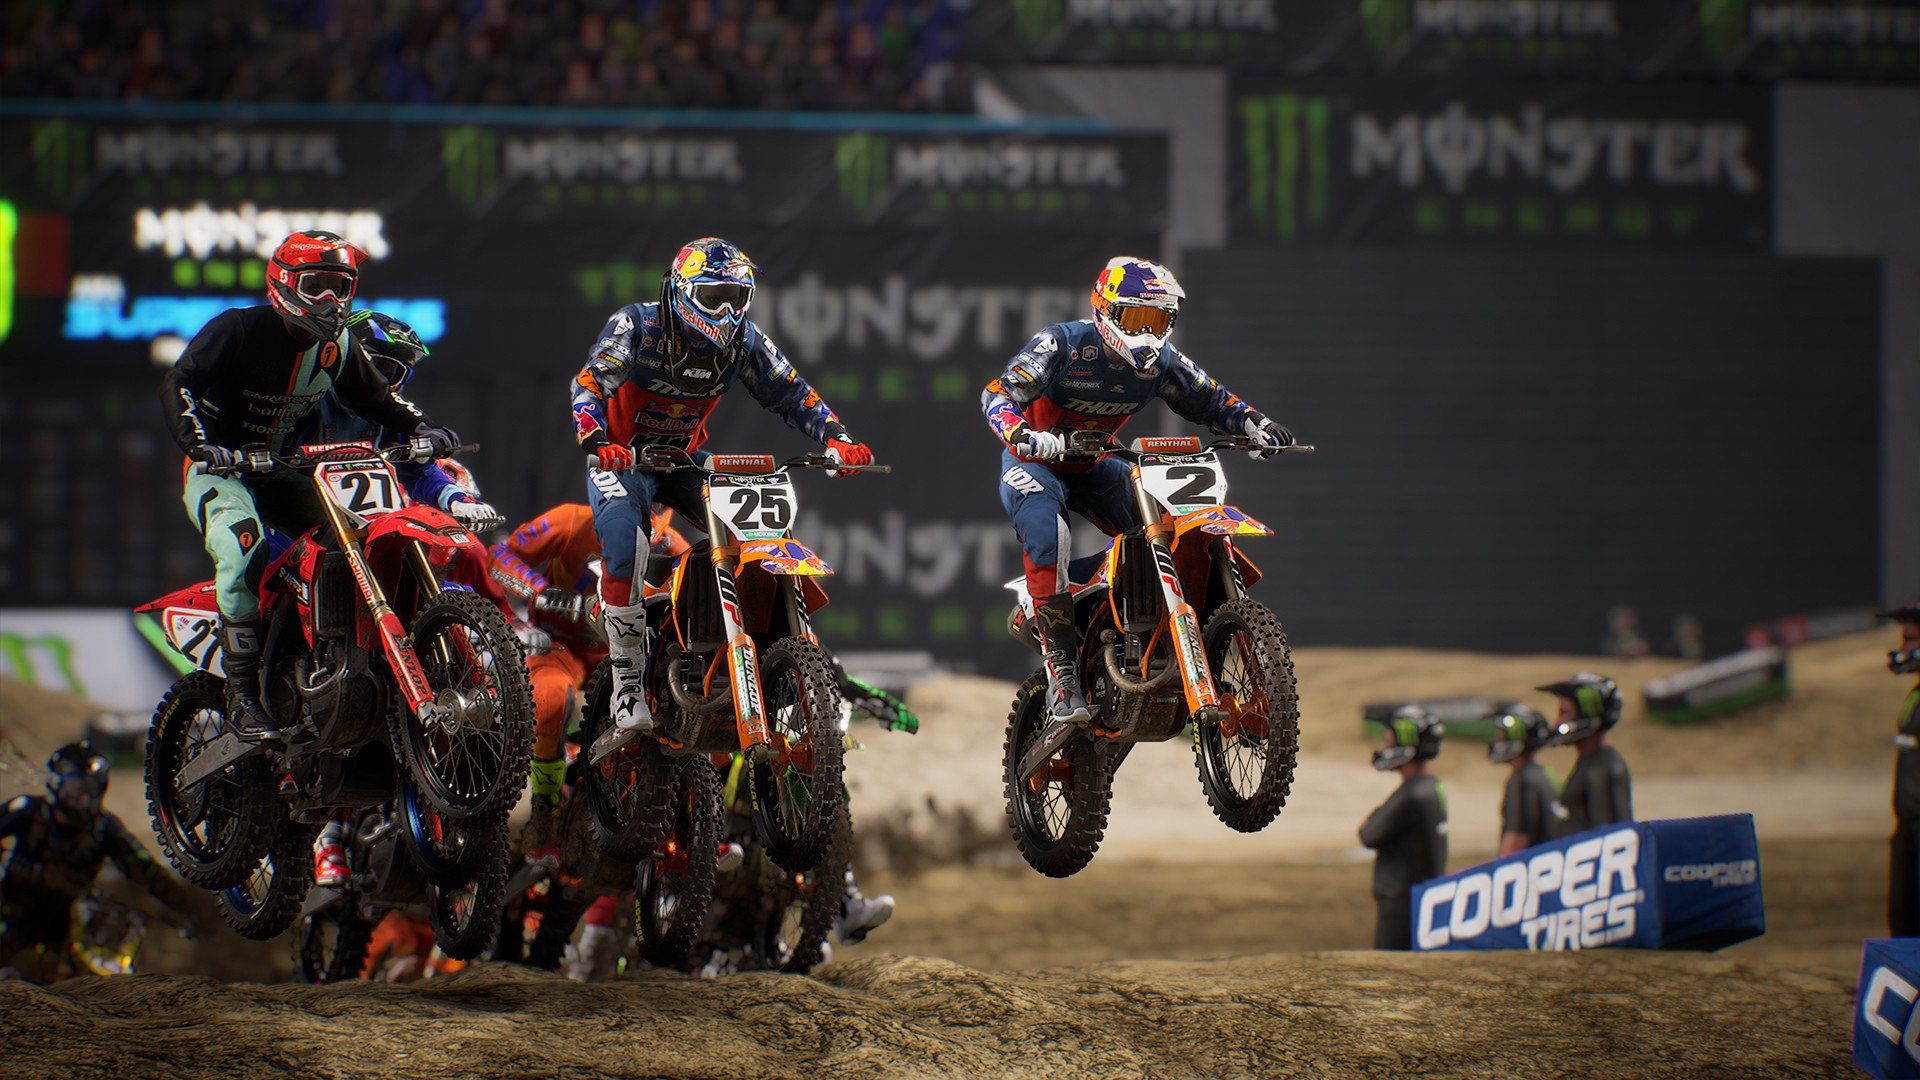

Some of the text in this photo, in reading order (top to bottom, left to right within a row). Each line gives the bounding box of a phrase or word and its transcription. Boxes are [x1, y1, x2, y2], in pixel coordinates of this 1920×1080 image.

[1351, 103, 1760, 194] MONSTER
[683, 369, 712, 380] KTM
[1063, 398, 1139, 415] THOR
[340, 472, 395, 512] 27
[1165, 466, 1217, 505] 2
[730, 488, 791, 530] 25
[1417, 828, 1640, 949] COOPER
[1664, 859, 1757, 882] COOPER
[1520, 894, 1637, 950] TIRES
